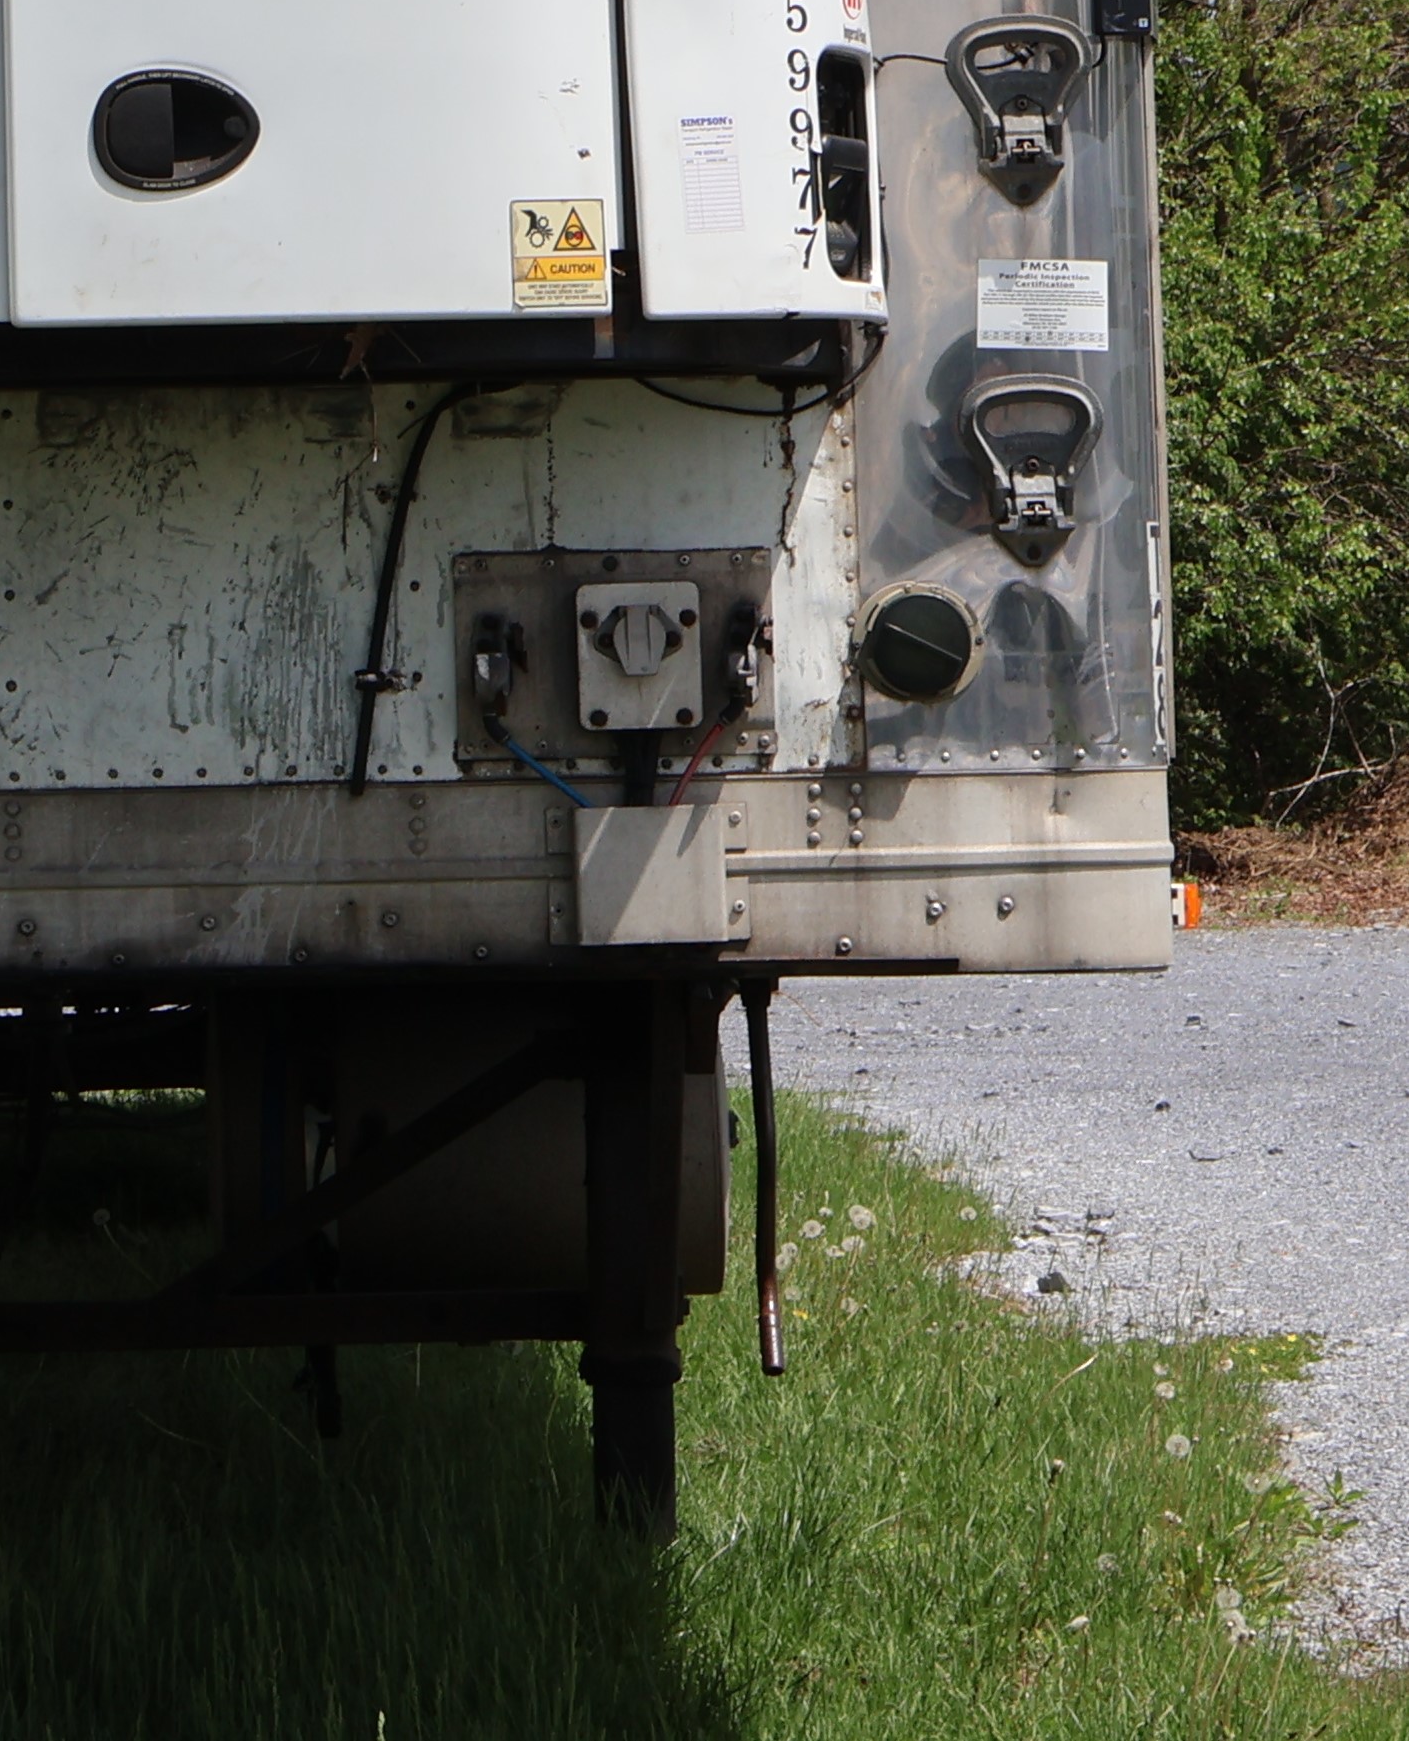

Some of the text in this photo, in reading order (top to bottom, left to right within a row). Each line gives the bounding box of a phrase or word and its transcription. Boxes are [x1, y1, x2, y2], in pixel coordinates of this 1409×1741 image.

[550, 263, 595, 274] CAUTION
[1020, 261, 1070, 272] FMCSA
[999, 272, 1090, 282] Periodic Inspection
